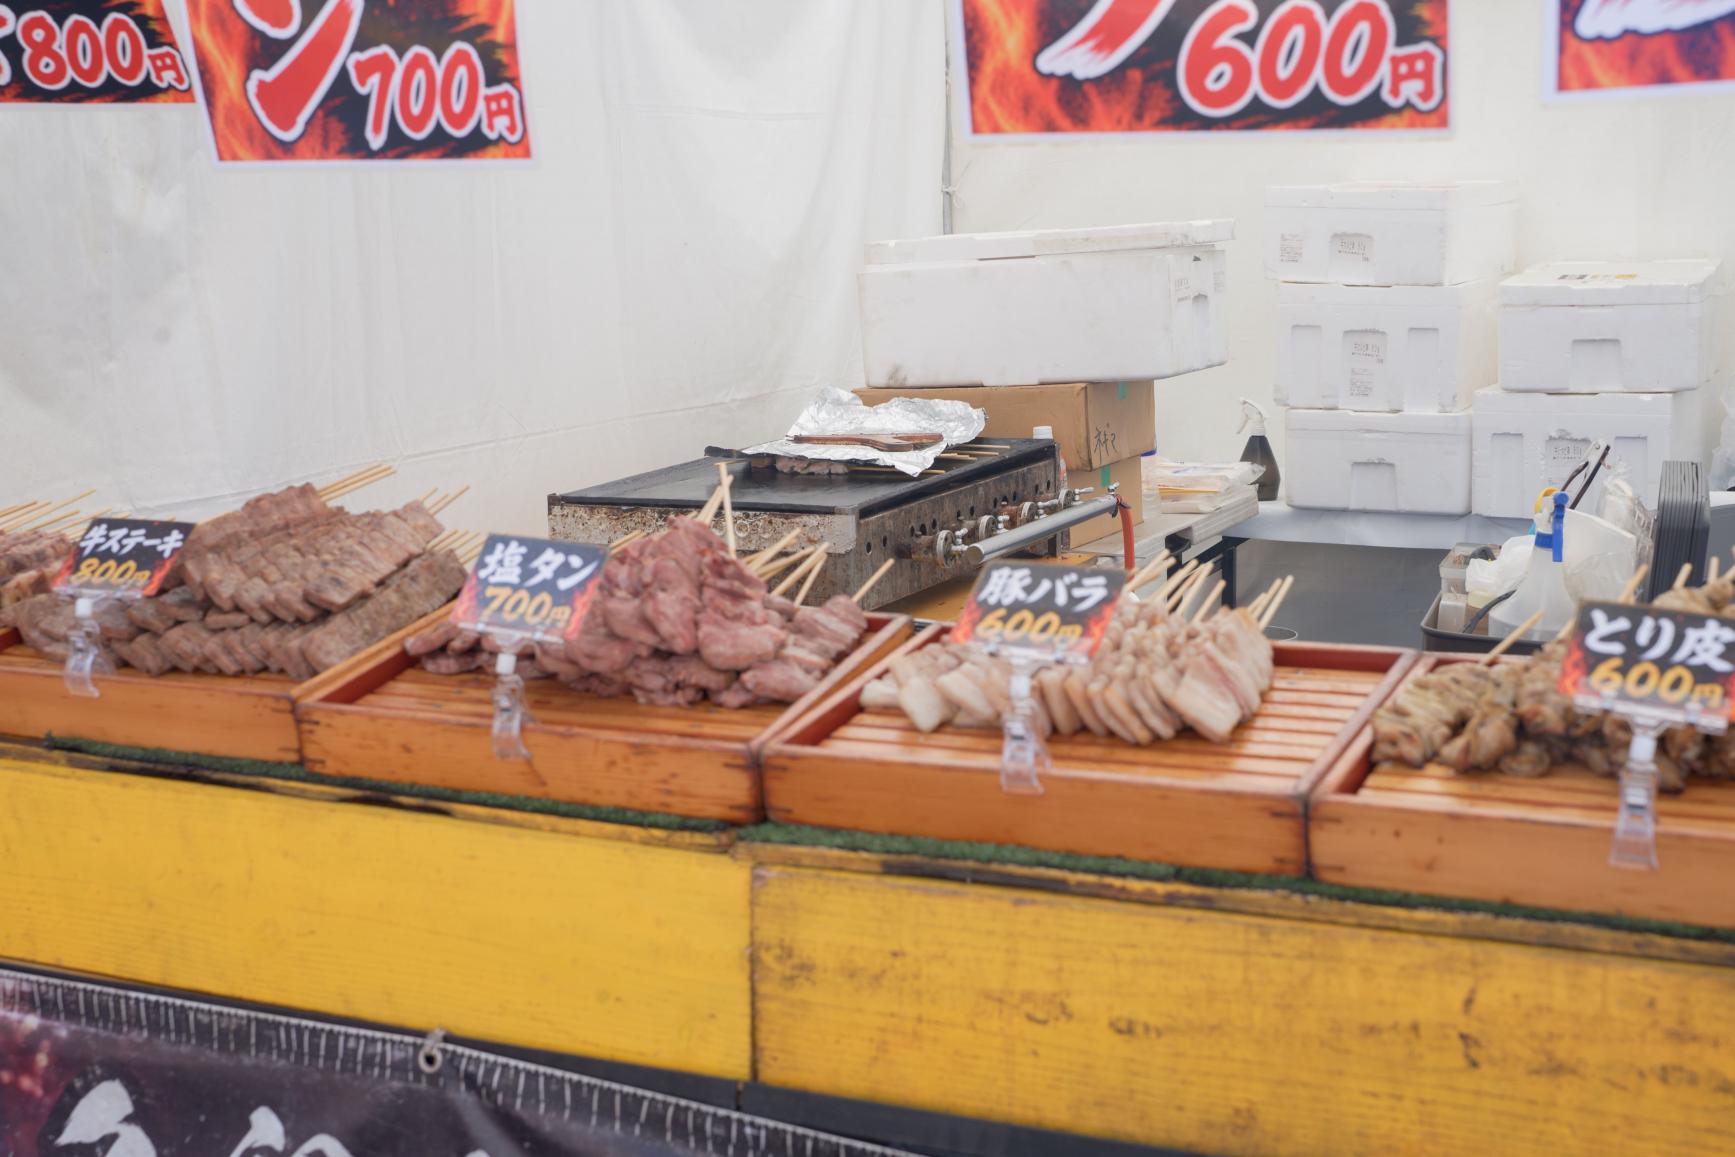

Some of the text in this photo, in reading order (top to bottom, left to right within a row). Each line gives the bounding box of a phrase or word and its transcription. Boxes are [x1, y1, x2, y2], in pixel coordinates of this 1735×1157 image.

[16, 10, 190, 90] 800円
[1177, 0, 1443, 117] 600円
[347, 41, 524, 150] 700円
[79, 523, 184, 558] 牛ステーキ
[69, 556, 151, 584] 800円
[977, 566, 1108, 612] 豚バラ
[480, 586, 572, 628] 700円
[975, 608, 1083, 643] 600円
[1584, 608, 1735, 672] とり皮
[1589, 657, 1725, 708] 600円
